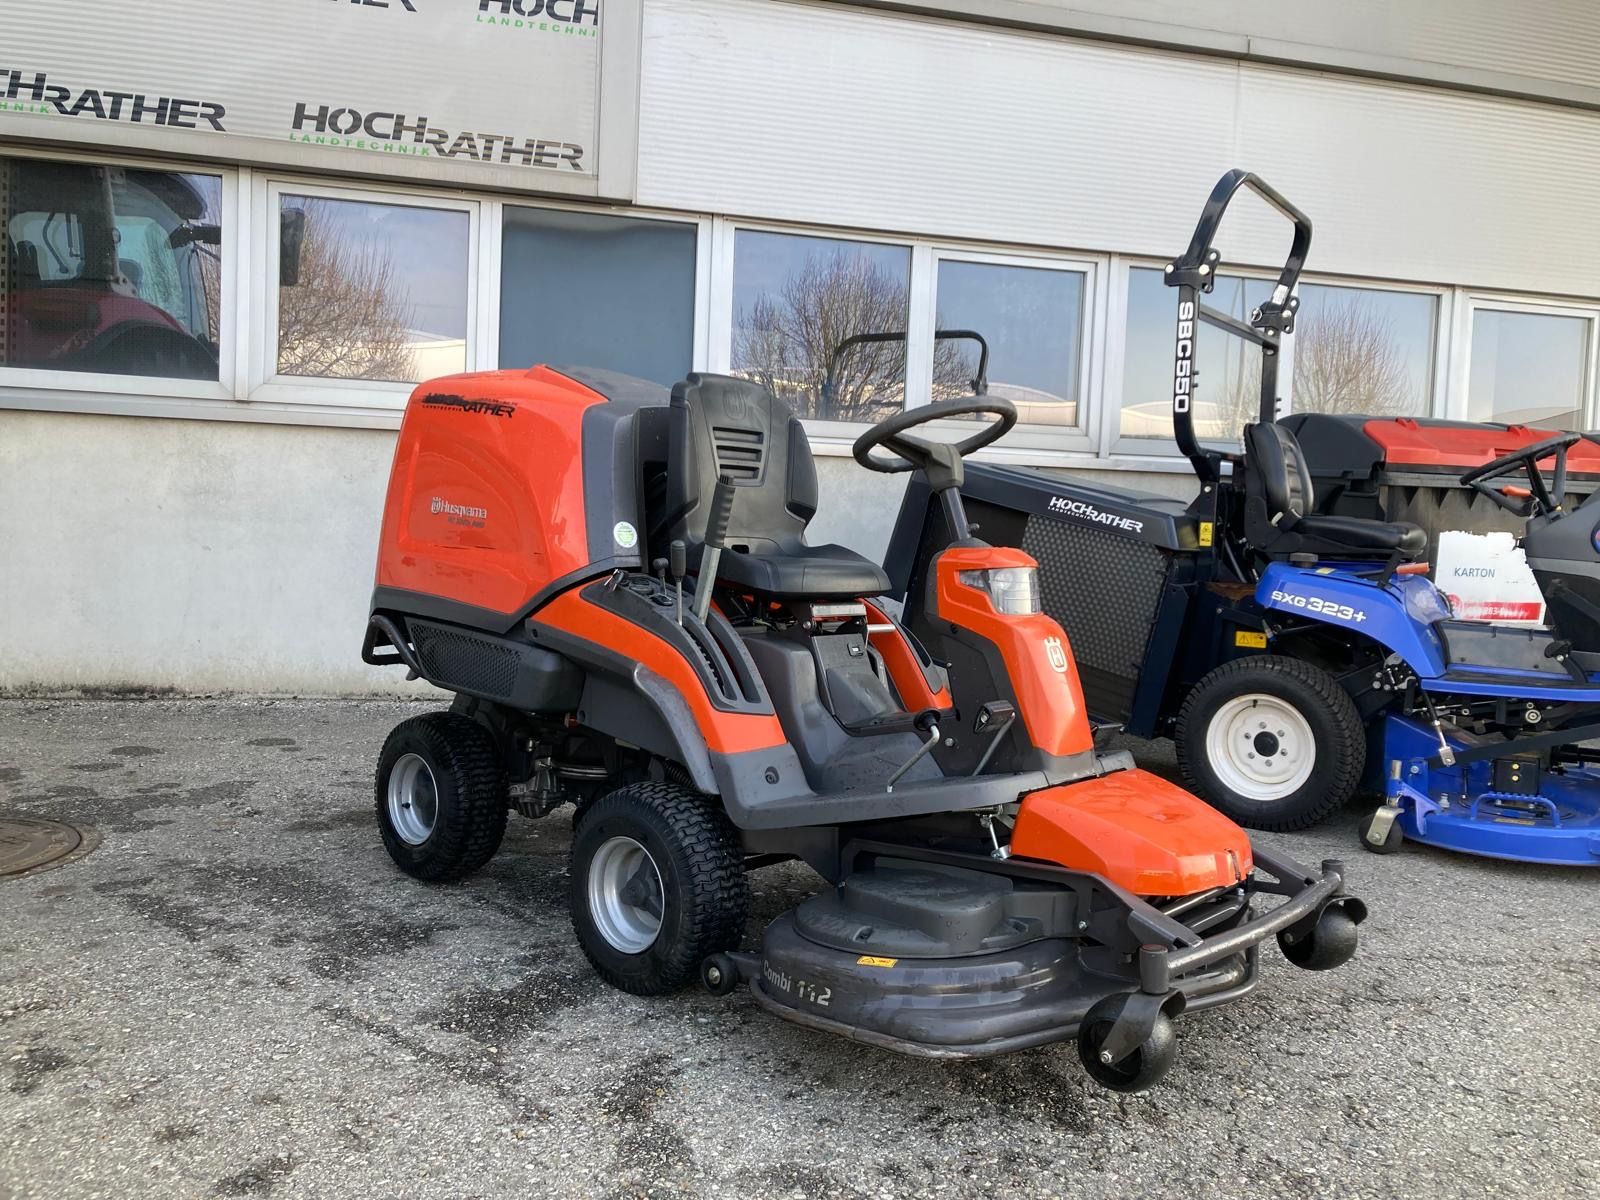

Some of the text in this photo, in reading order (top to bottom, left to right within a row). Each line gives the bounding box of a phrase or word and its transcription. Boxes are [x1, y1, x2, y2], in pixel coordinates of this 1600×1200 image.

[476, 15, 597, 37] LANDTECHNI
[289, 133, 431, 156] LANDTECHNIK
[292, 102, 584, 171] HOCHRATHER
[1174, 301, 1194, 413] SBC550
[1049, 496, 1143, 533] HOCHRATHER
[1454, 567, 1496, 578] KARTON
[1271, 590, 1367, 622] SXG 323+
[763, 960, 792, 992] Combi
